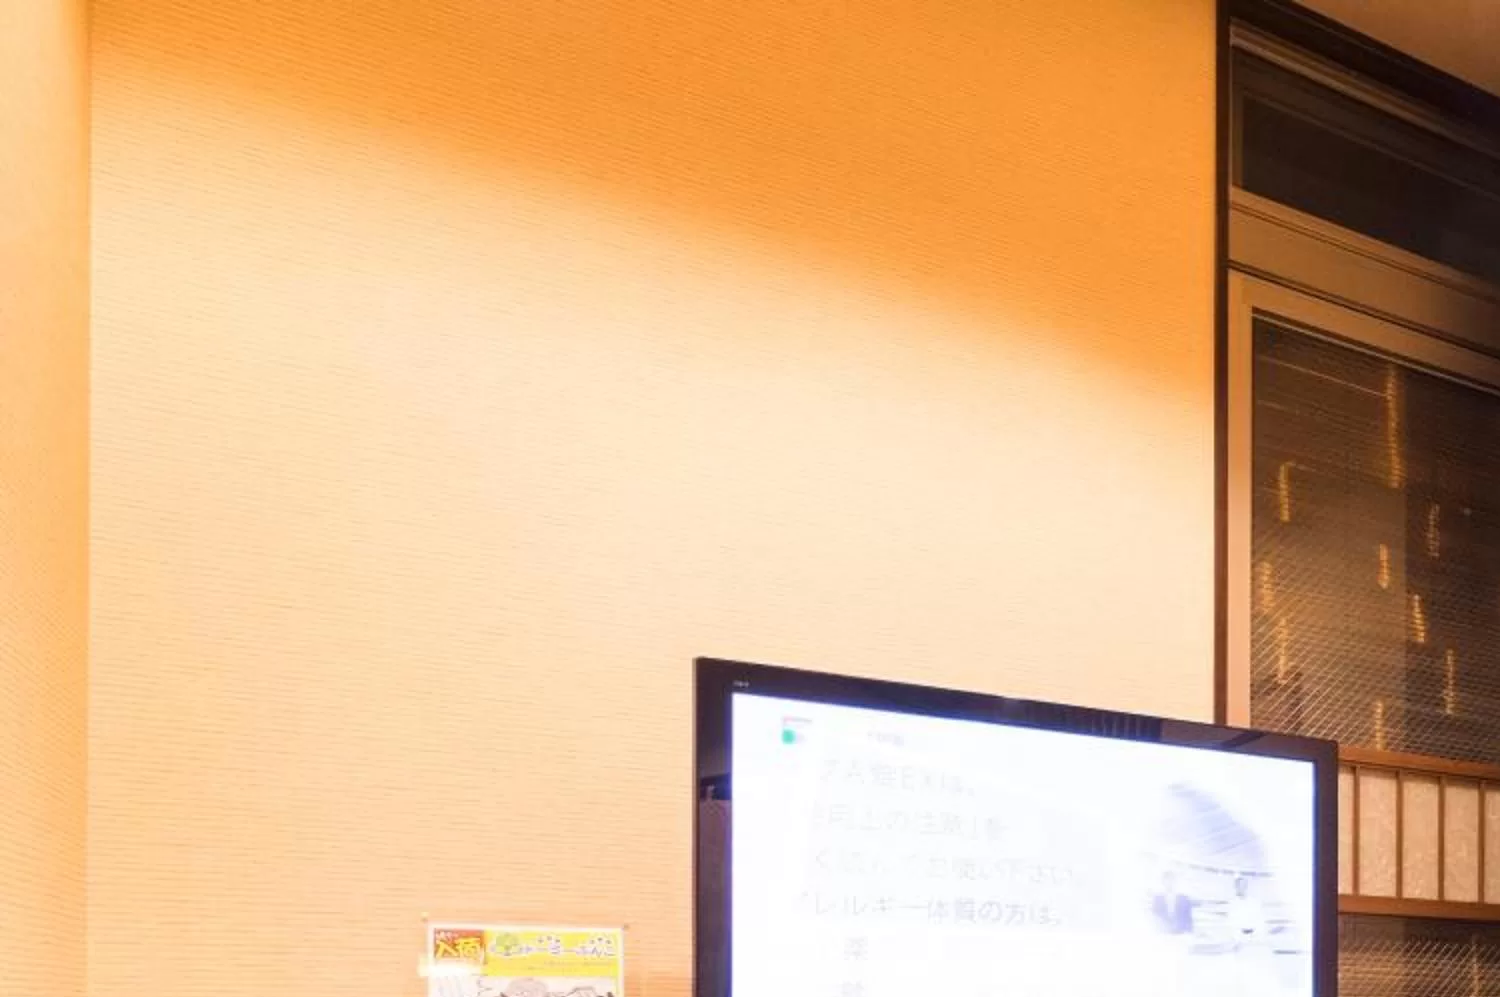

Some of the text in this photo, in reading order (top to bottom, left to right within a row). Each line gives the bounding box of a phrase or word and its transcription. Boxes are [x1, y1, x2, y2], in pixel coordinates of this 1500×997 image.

[802, 889, 1062, 926] レルギー体質の方は、
